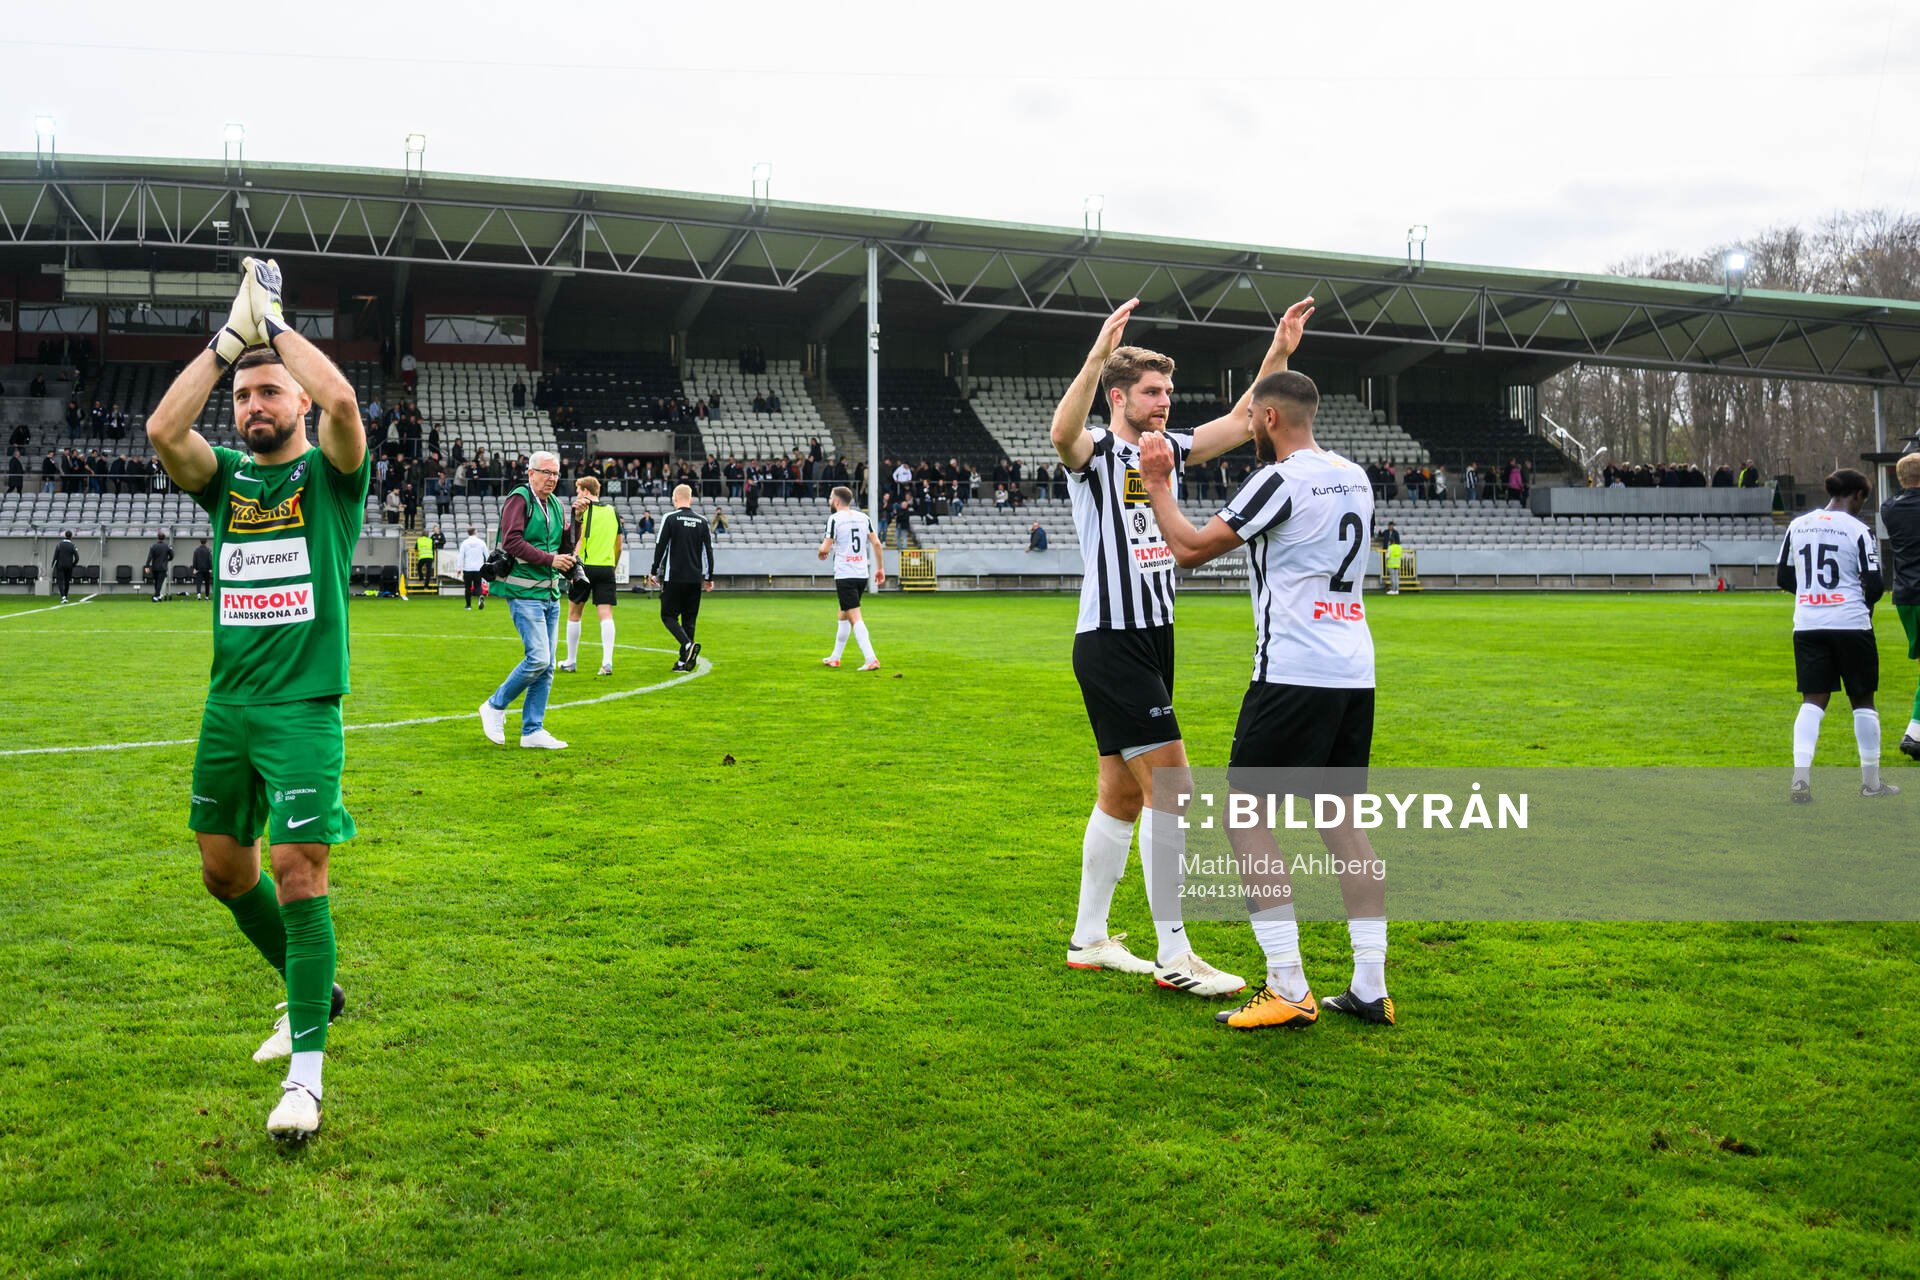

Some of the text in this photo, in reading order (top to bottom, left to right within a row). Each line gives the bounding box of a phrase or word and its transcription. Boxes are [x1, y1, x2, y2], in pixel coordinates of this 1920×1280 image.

[1311, 483, 1369, 496] Kundpartne
[851, 528, 861, 553] 5
[246, 551, 299, 566] NÄTVERKET
[1134, 546, 1171, 561] FLYTGO
[1329, 511, 1363, 593] 2
[1799, 543, 1840, 589] 15
[224, 590, 308, 609] FLYTGOLV
[1799, 593, 1846, 605] PULS
[229, 609, 291, 620] LANDSKRONA
[294, 607, 308, 616] AB
[1314, 601, 1364, 621] PULS
